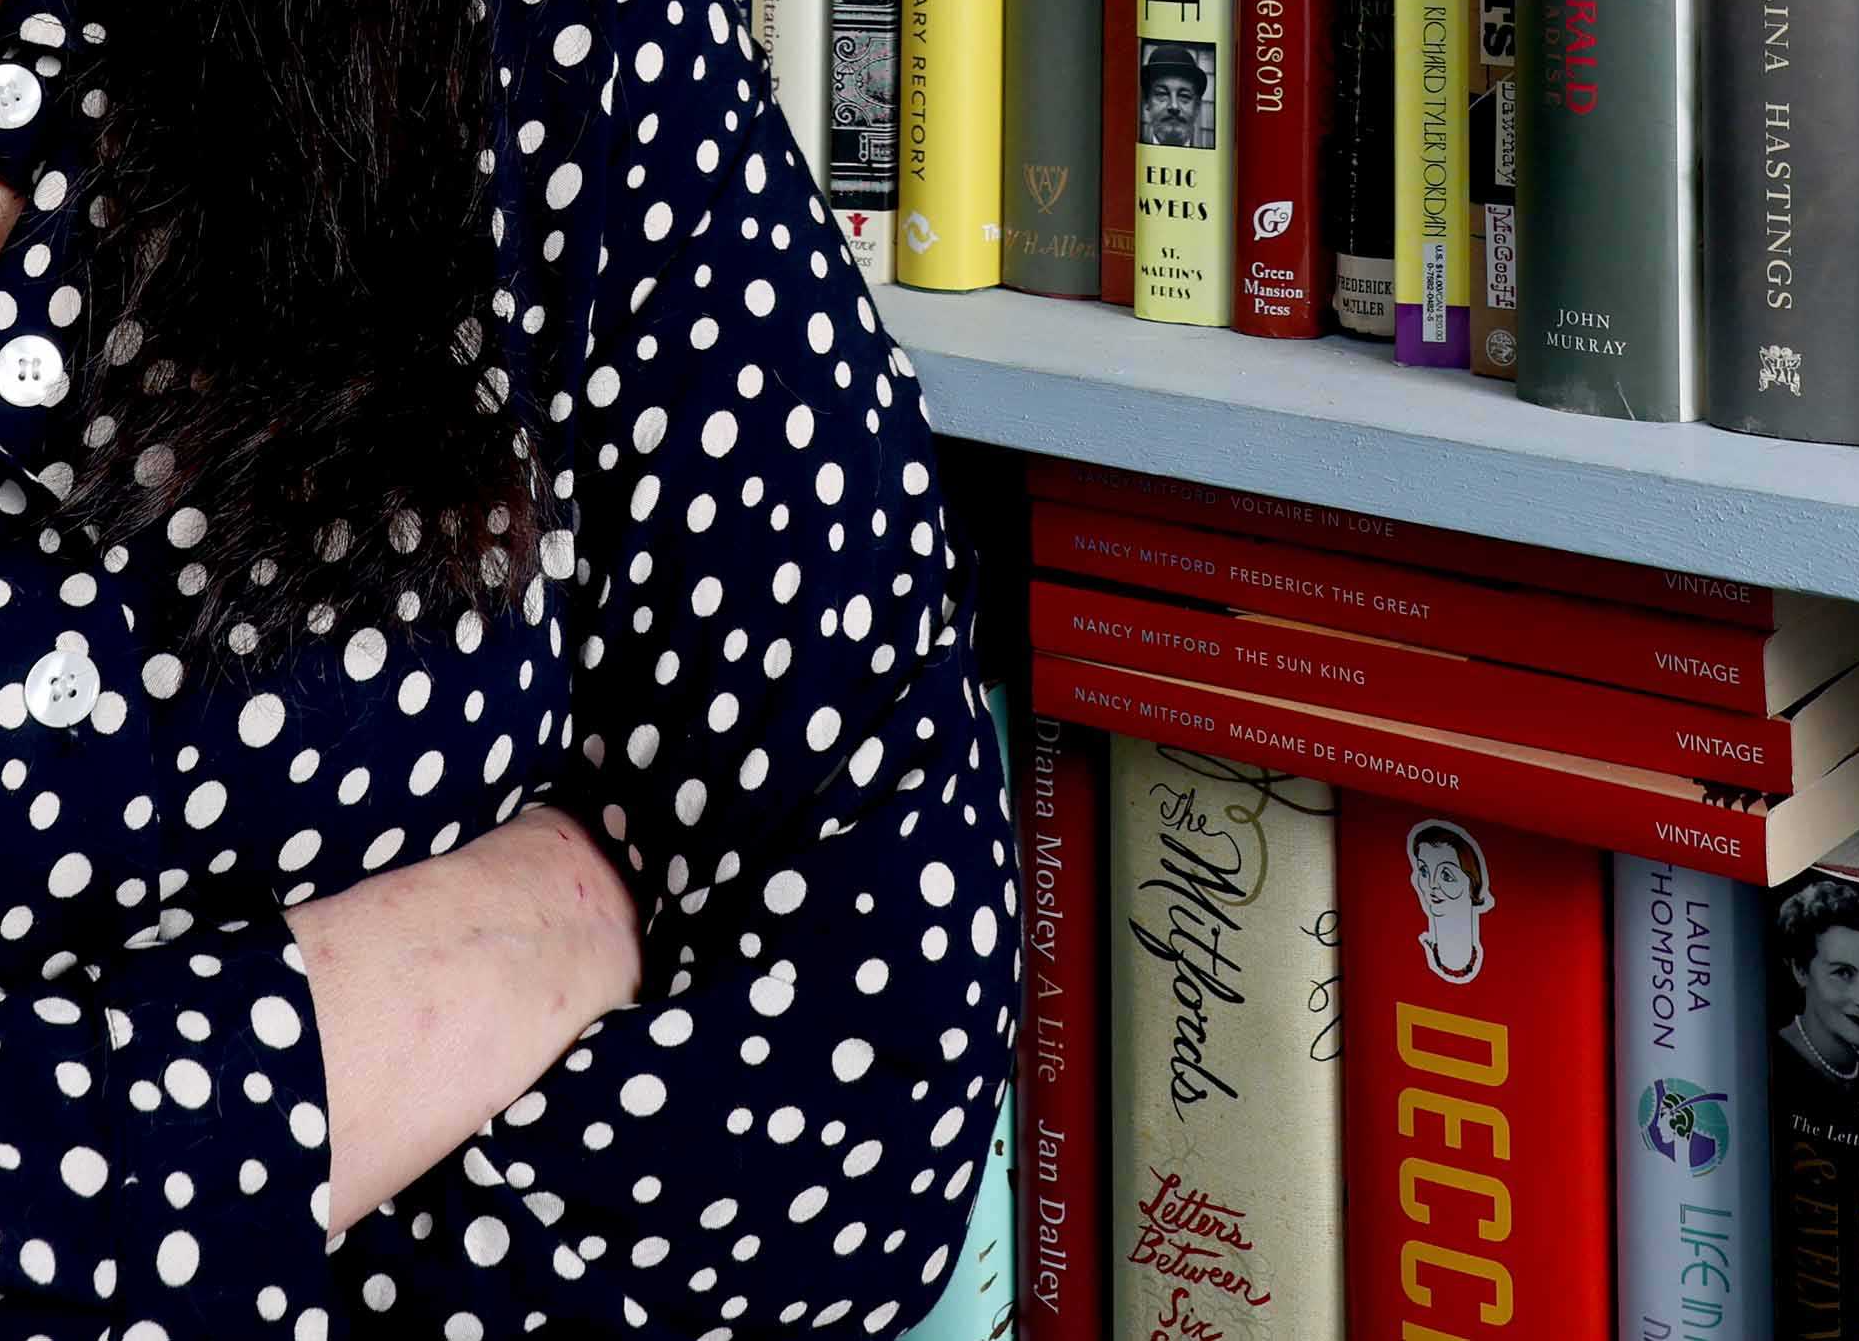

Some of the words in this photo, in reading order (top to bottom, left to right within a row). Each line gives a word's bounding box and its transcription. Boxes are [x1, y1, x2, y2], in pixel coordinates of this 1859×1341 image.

[910, 56, 927, 182] RECTORY
[1145, 165, 1198, 189] ERIC
[1137, 196, 1208, 221] MYERS
[1765, 102, 1792, 311] HASTINGS
[1251, 262, 1295, 281] Green
[1244, 278, 1304, 300] Mansion
[1254, 298, 1291, 317] Press
[1557, 309, 1611, 330] JOHN
[1545, 333, 1627, 356] MURRAY
[1072, 615, 1134, 641] NANCY
[1140, 628, 1221, 658] MITFORD
[1235, 647, 1271, 667] THE
[1275, 653, 1312, 674] SUN
[1319, 661, 1367, 687] KING
[1073, 685, 1134, 712] NANCY
[1140, 701, 1217, 732] MITFORD
[1229, 723, 1308, 755] MADAME
[1313, 741, 1337, 760] DE
[1344, 749, 1461, 791] POMPADOUR
[1675, 731, 1766, 765] VINTAGE
[1655, 822, 1743, 858] VINTAGE
[1650, 862, 1676, 1050] THOMPSON
[1685, 899, 1711, 1013] LAURA
